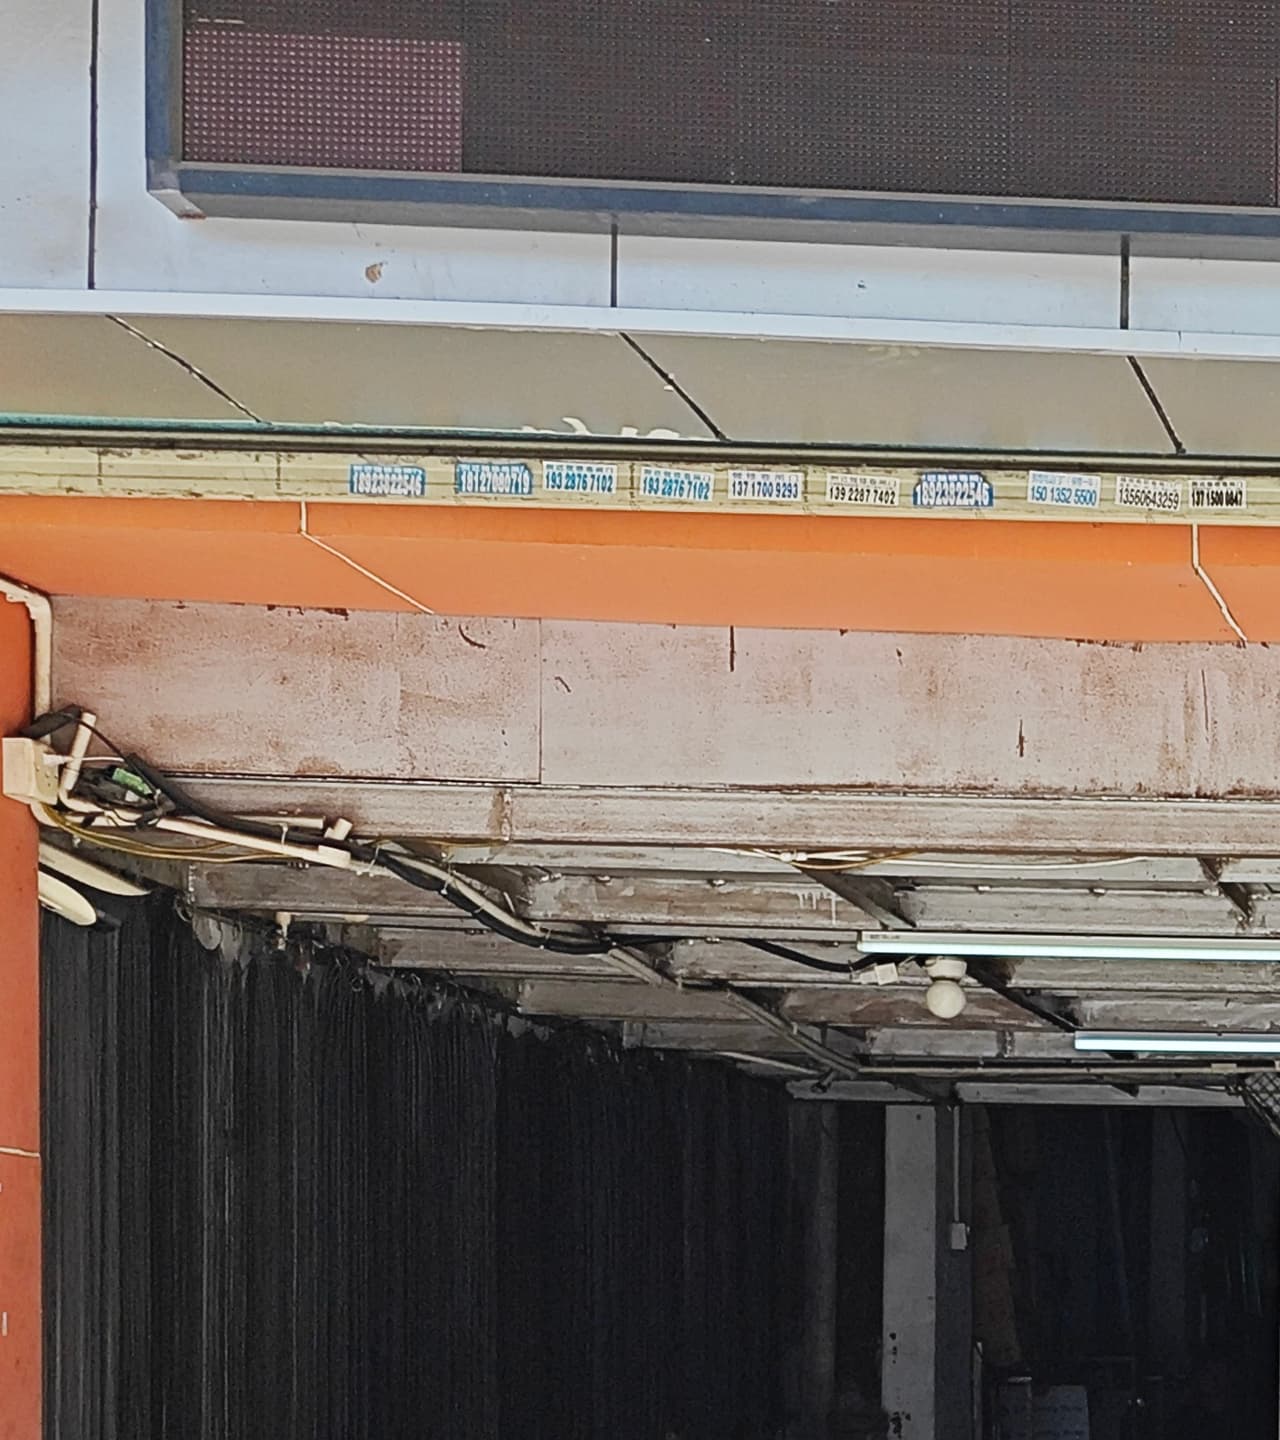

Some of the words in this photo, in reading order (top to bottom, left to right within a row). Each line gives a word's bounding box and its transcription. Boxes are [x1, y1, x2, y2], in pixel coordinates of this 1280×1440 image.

[732, 481, 748, 497] 137
[752, 481, 773, 497] 1700
[775, 483, 798, 499] 9293
[830, 486, 845, 501] 139
[848, 487, 870, 503] 2287
[873, 489, 896, 504] 7402
